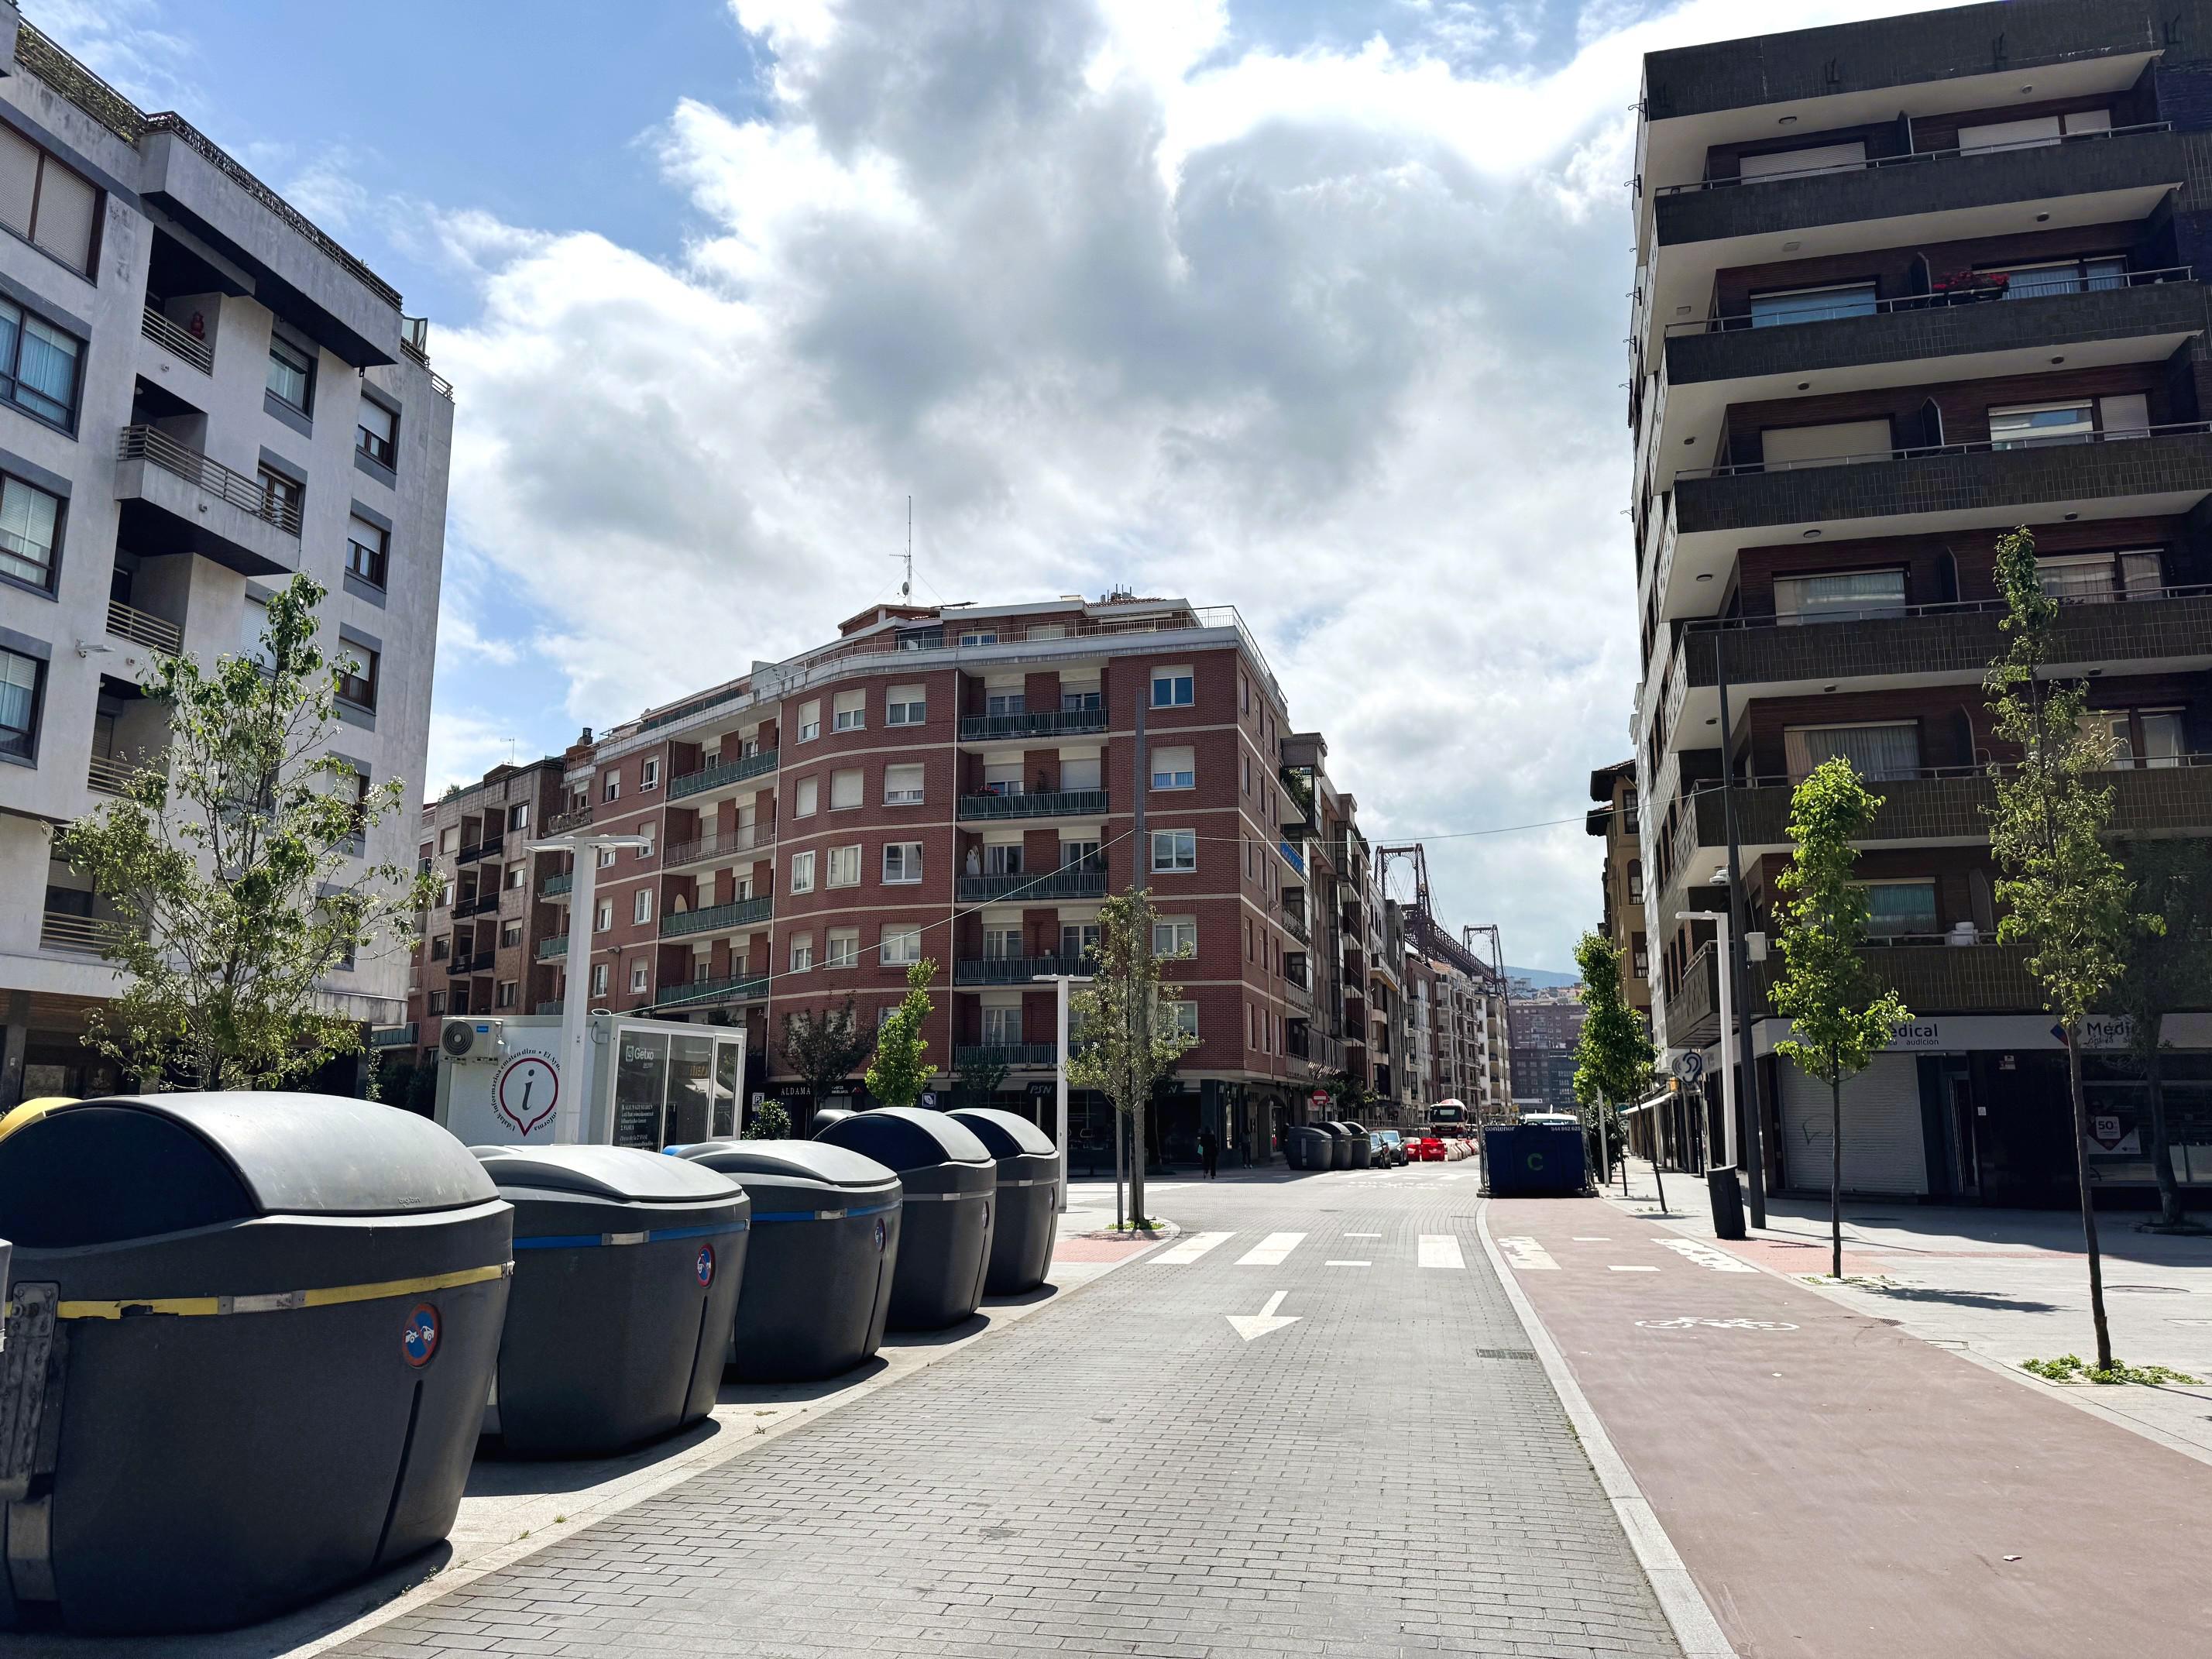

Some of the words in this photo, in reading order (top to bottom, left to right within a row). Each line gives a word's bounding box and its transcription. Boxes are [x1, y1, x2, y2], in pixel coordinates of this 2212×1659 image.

[1891, 1023, 1939, 1037] edical
[634, 1047, 654, 1060] Getxo
[781, 1087, 811, 1096] ALDAMA
[1029, 1085, 1053, 1094] PSN
[2098, 1121, 2114, 1130] 50
[1527, 1152, 1544, 1171] C
